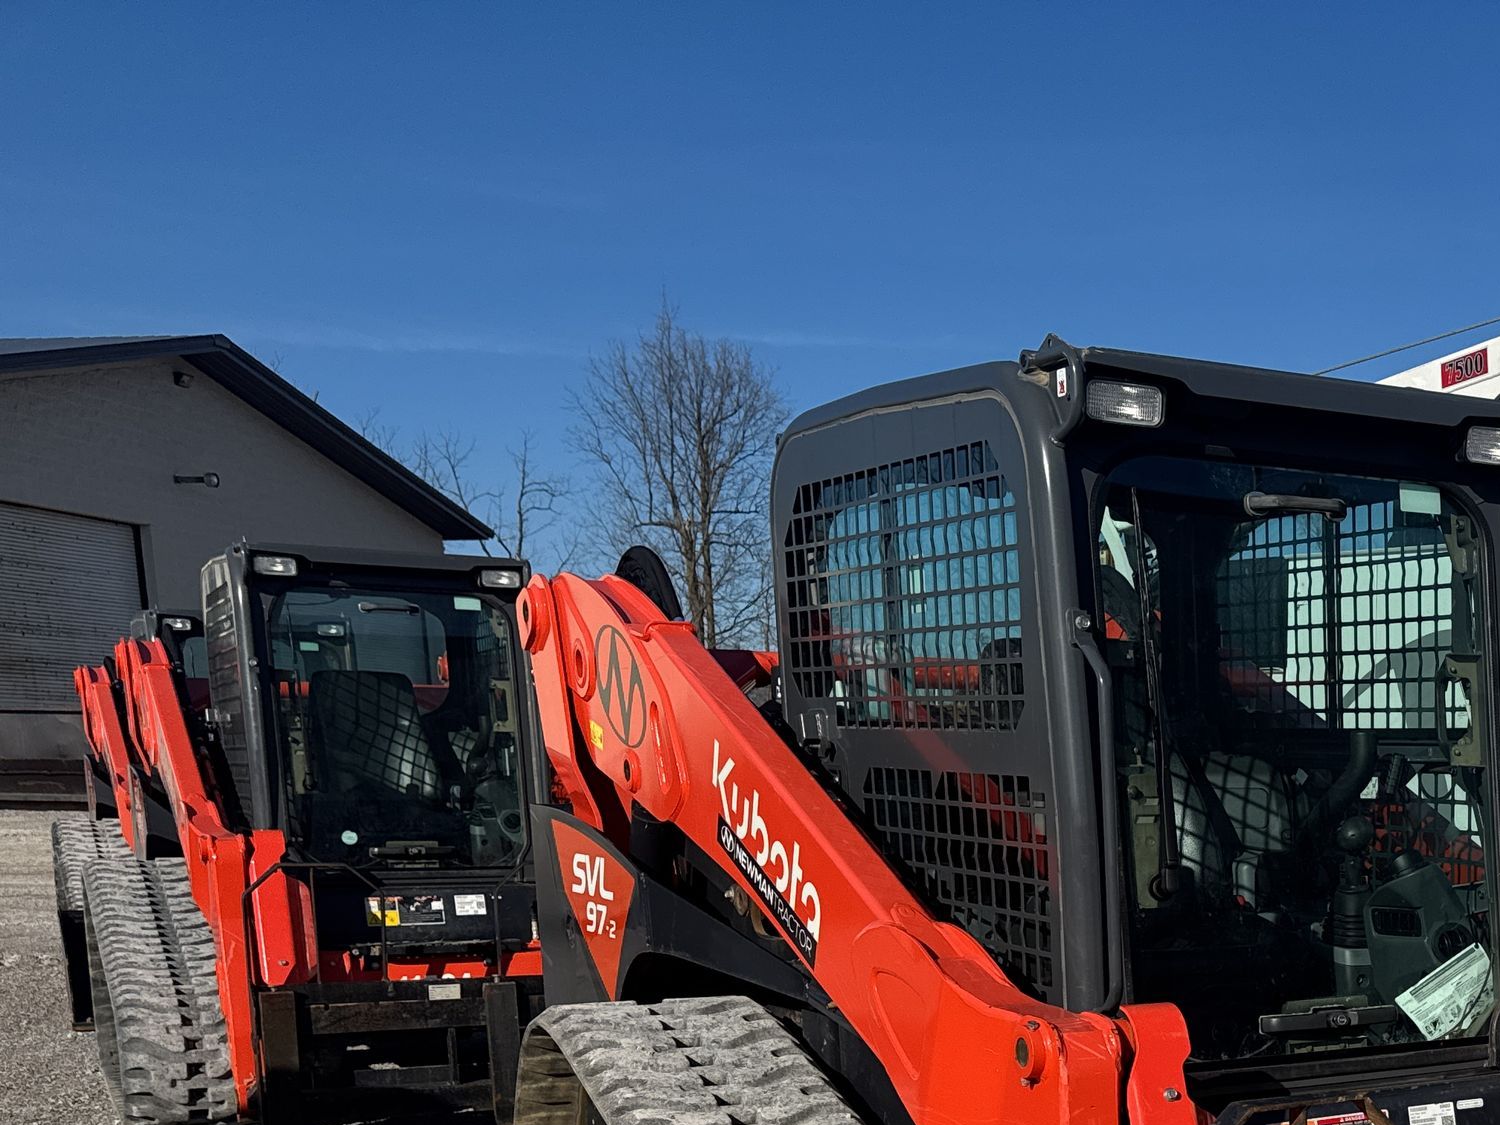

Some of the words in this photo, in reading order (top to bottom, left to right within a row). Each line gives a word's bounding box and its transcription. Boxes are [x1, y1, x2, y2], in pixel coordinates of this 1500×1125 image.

[1444, 352, 1484, 385] 7500
[712, 738, 821, 943] Kubota
[572, 853, 614, 901] SVL
